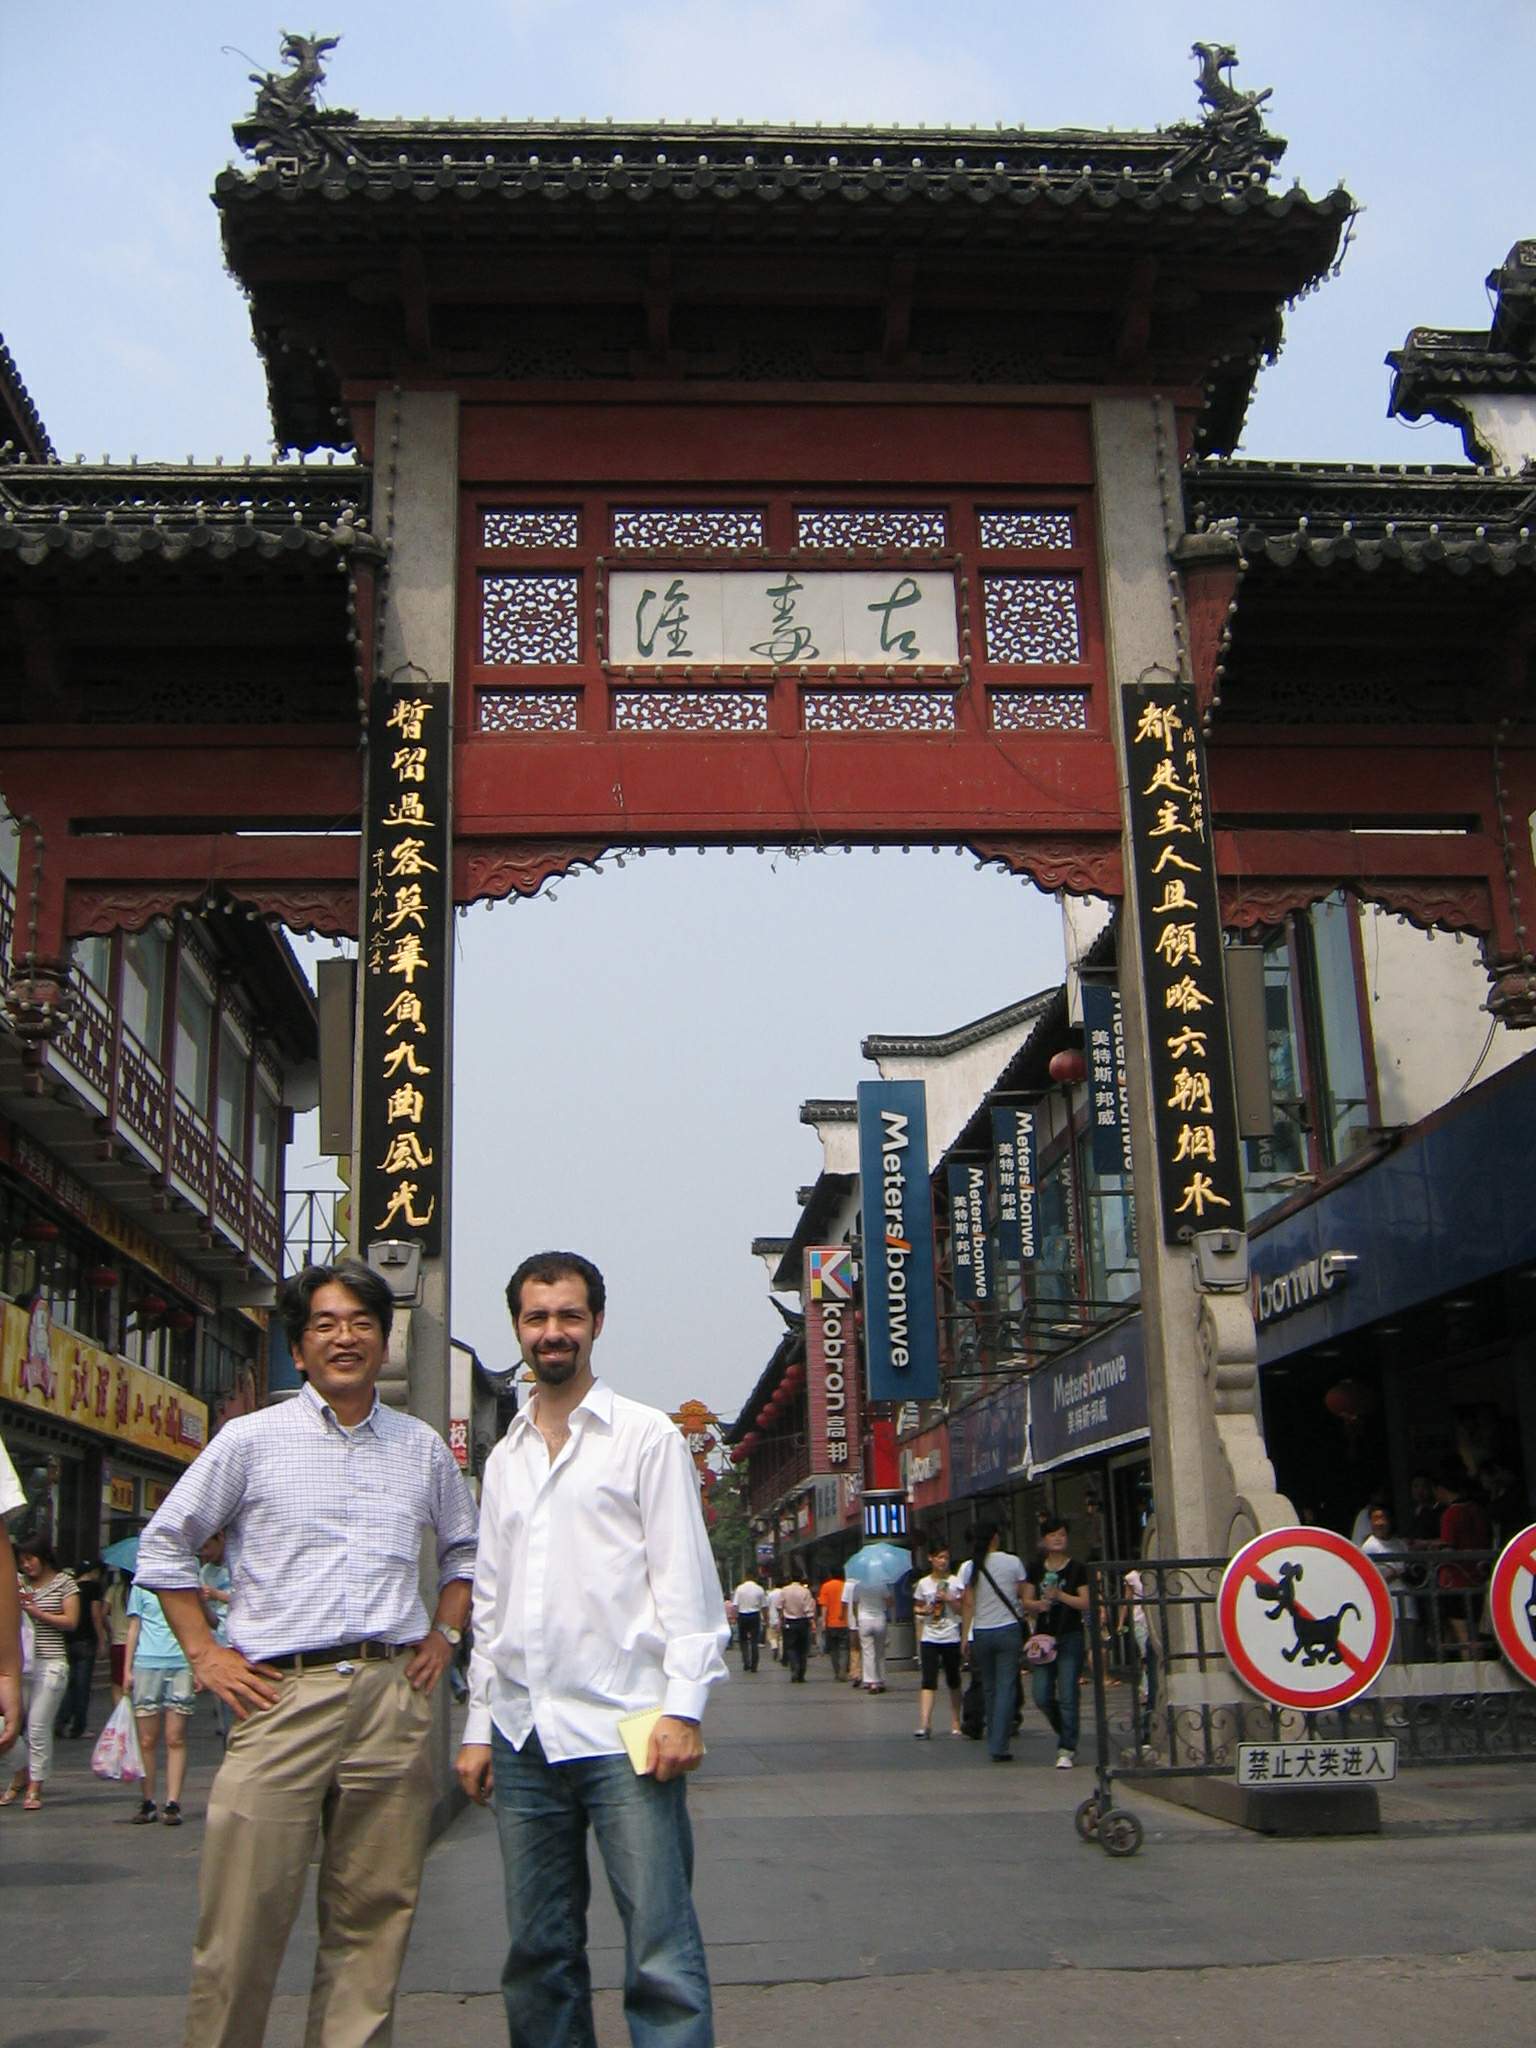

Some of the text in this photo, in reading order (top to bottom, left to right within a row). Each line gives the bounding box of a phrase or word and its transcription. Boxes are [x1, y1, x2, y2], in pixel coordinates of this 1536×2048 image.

[822, 1302, 846, 1411] kobron
[826, 1415, 848, 1464] 高邦
[1248, 1747, 1386, 1780] 禁止犬类进入
